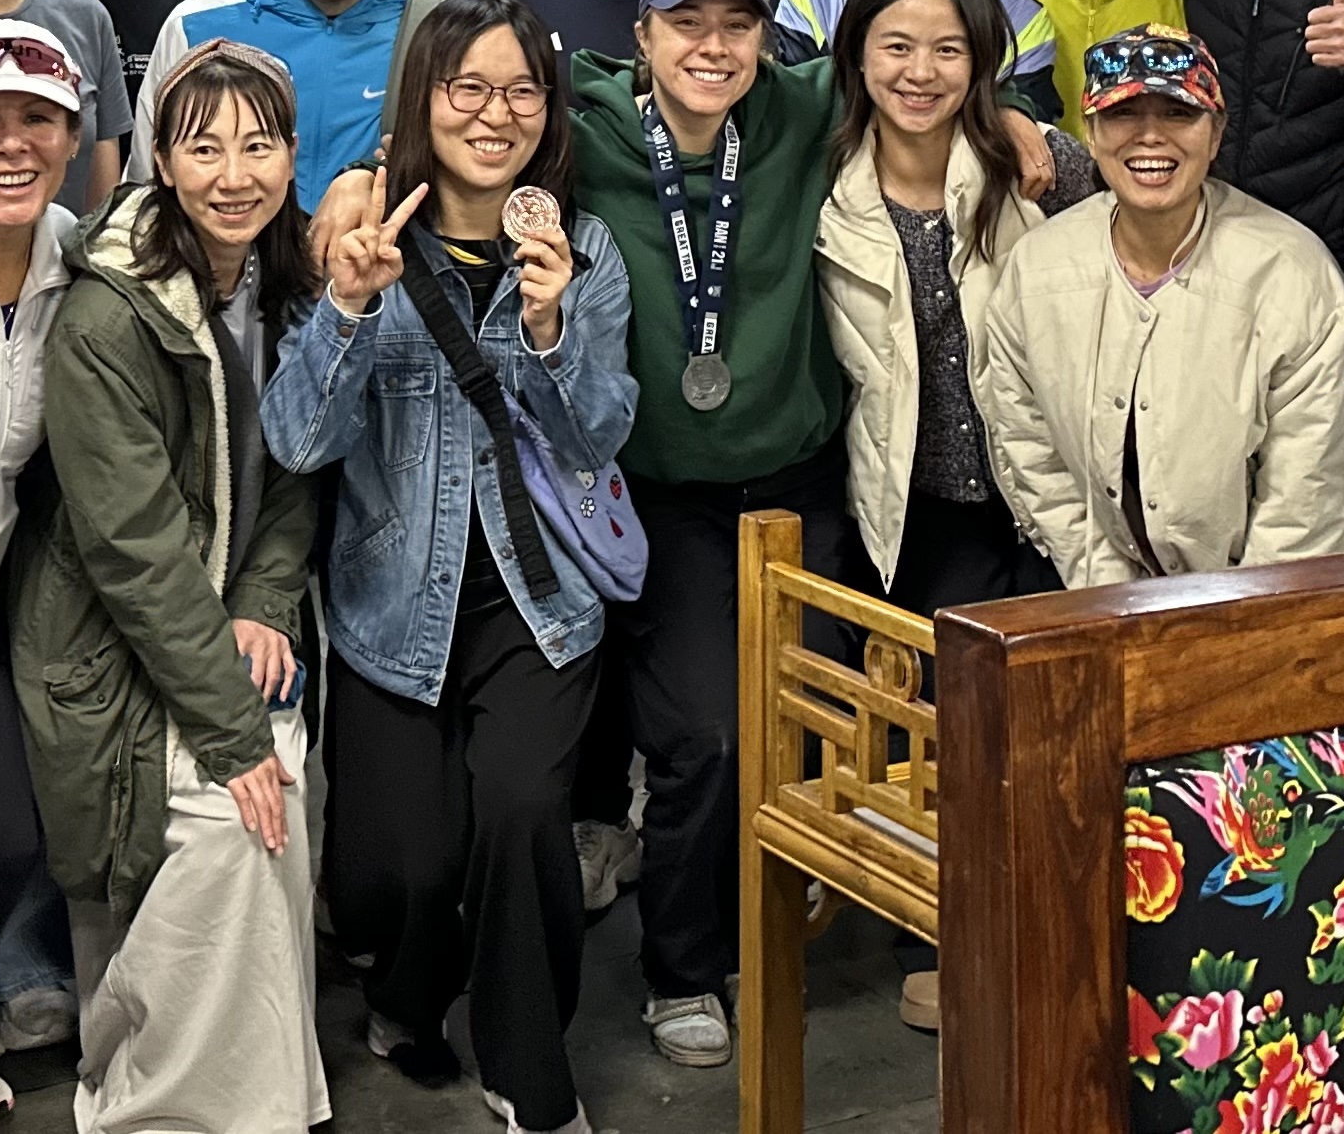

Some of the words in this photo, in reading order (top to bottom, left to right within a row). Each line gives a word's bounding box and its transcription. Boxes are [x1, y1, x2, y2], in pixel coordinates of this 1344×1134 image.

[724, 153, 736, 178] TREK
[674, 219, 689, 251] GREAT
[680, 252, 694, 279] TREK
